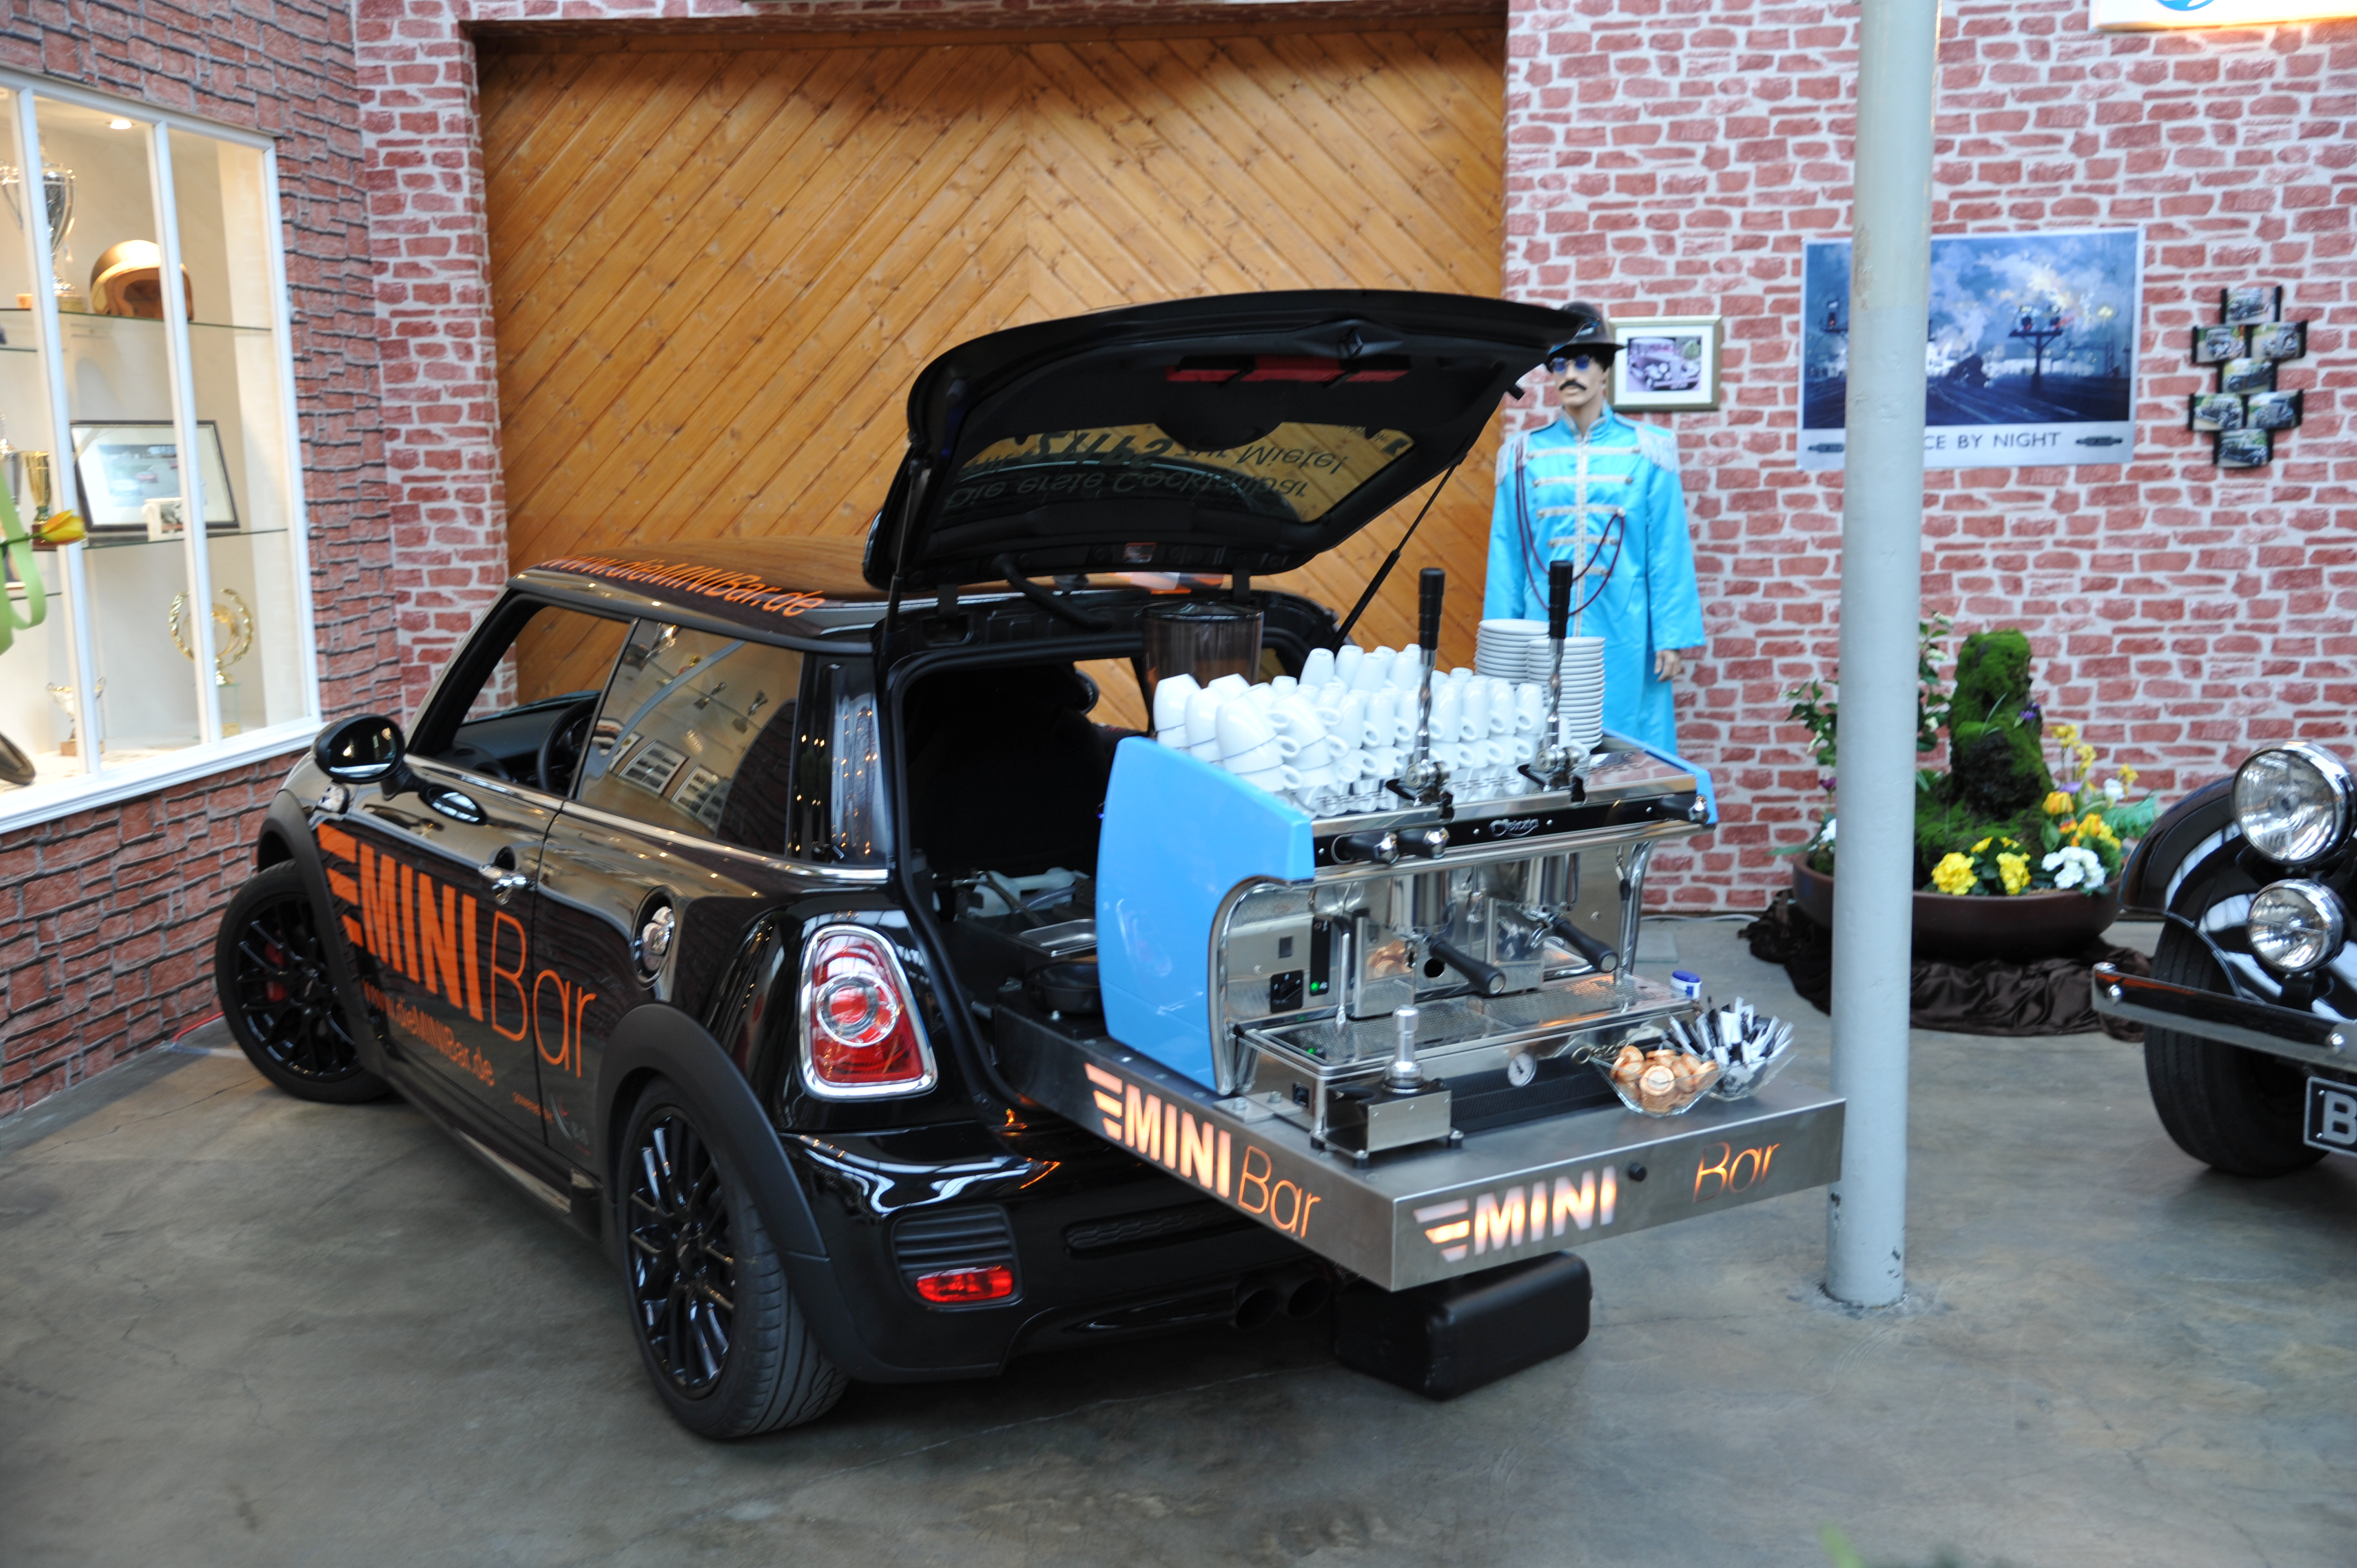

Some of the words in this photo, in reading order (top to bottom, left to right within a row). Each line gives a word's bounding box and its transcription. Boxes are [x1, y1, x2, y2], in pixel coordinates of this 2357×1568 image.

[1957, 434, 1983, 450] BY
[1993, 432, 2062, 448] NIGHT
[491, 910, 597, 1079] Bar
[1124, 1083, 1232, 1199] MINI
[1237, 1145, 1321, 1239] Bar
[1473, 1165, 1617, 1256] MINI
[1692, 1141, 1781, 1203] Bar
